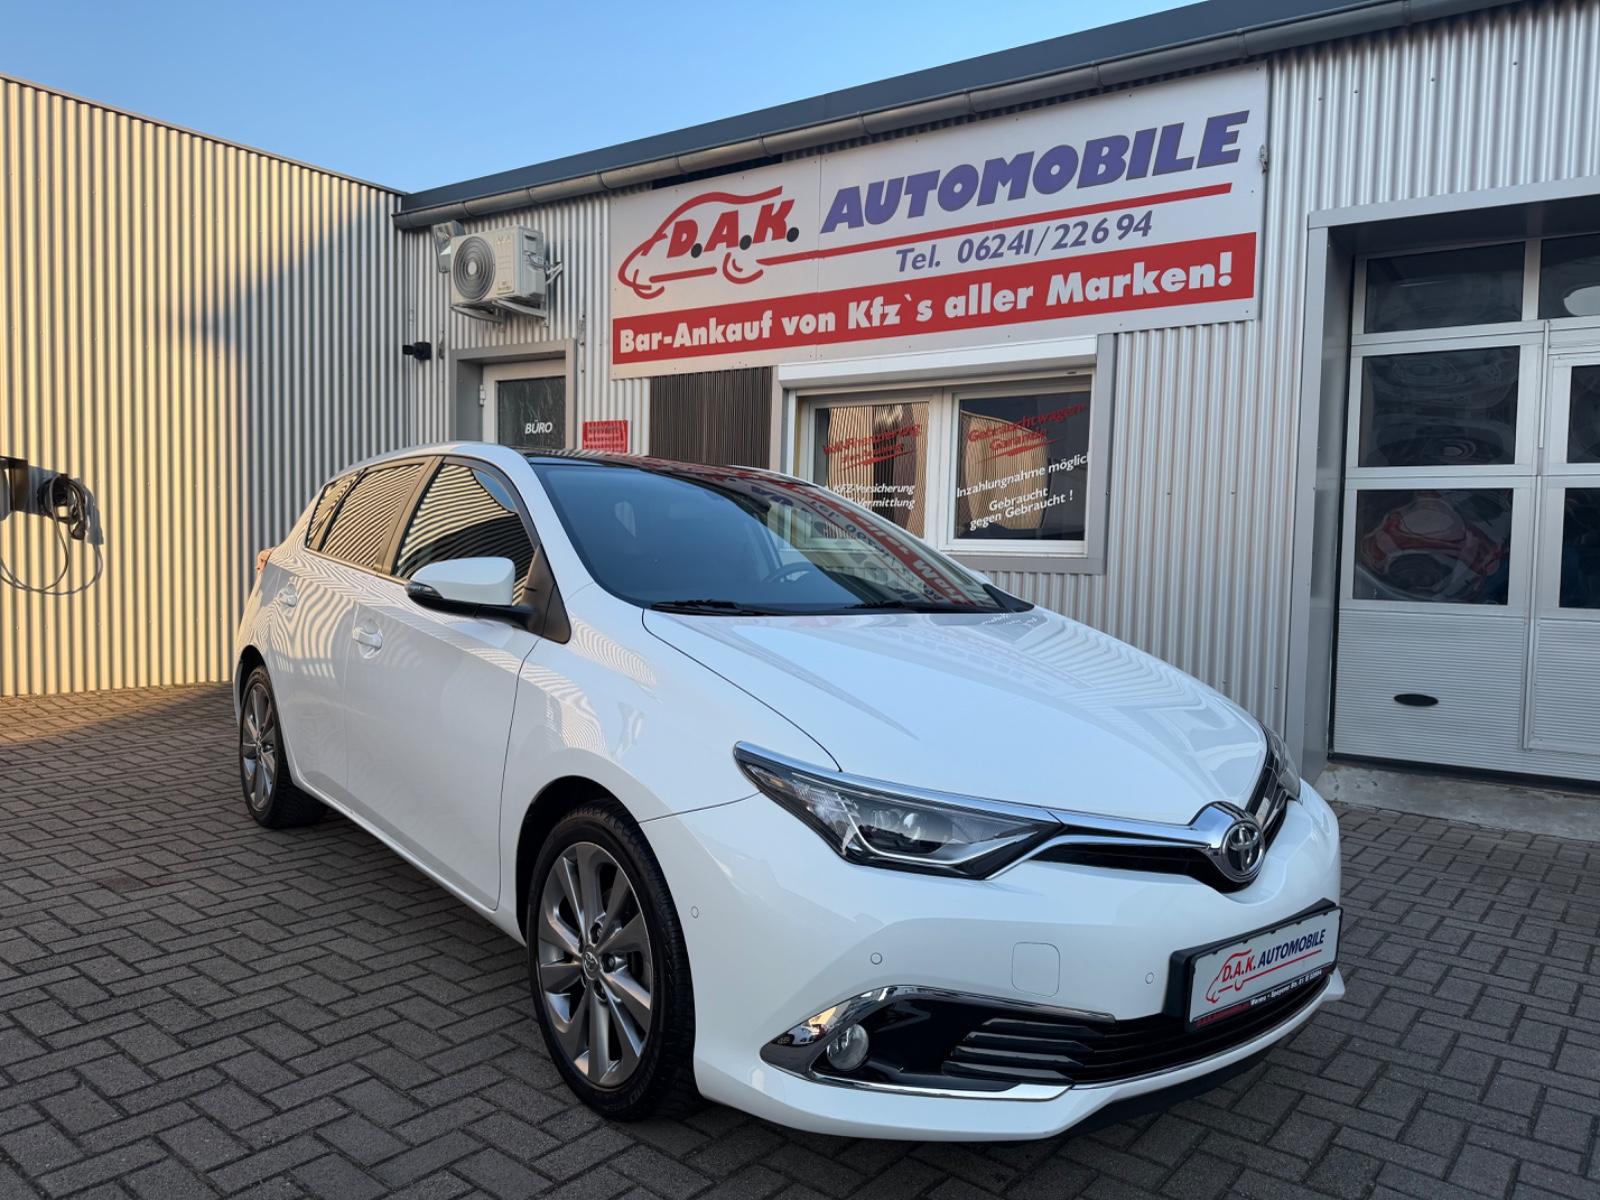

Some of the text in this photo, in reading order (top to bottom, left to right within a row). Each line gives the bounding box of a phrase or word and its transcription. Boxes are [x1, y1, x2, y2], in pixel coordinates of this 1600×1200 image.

[820, 110, 1250, 234] AUTOMOBILE
[896, 247, 941, 273] Tel.
[618, 310, 773, 354] Bar-Ankauf
[781, 312, 836, 336] von
[944, 280, 1034, 319] aller
[1046, 251, 1233, 306] Marken!
[525, 420, 553, 434] BÜRO
[956, 467, 1046, 499] Inzahlungnahme
[989, 488, 1049, 512] Gebraucht
[969, 514, 1003, 533] gegen
[1005, 495, 1067, 520] Gebraucht
[1258, 929, 1326, 969] AUTOMOBILE
